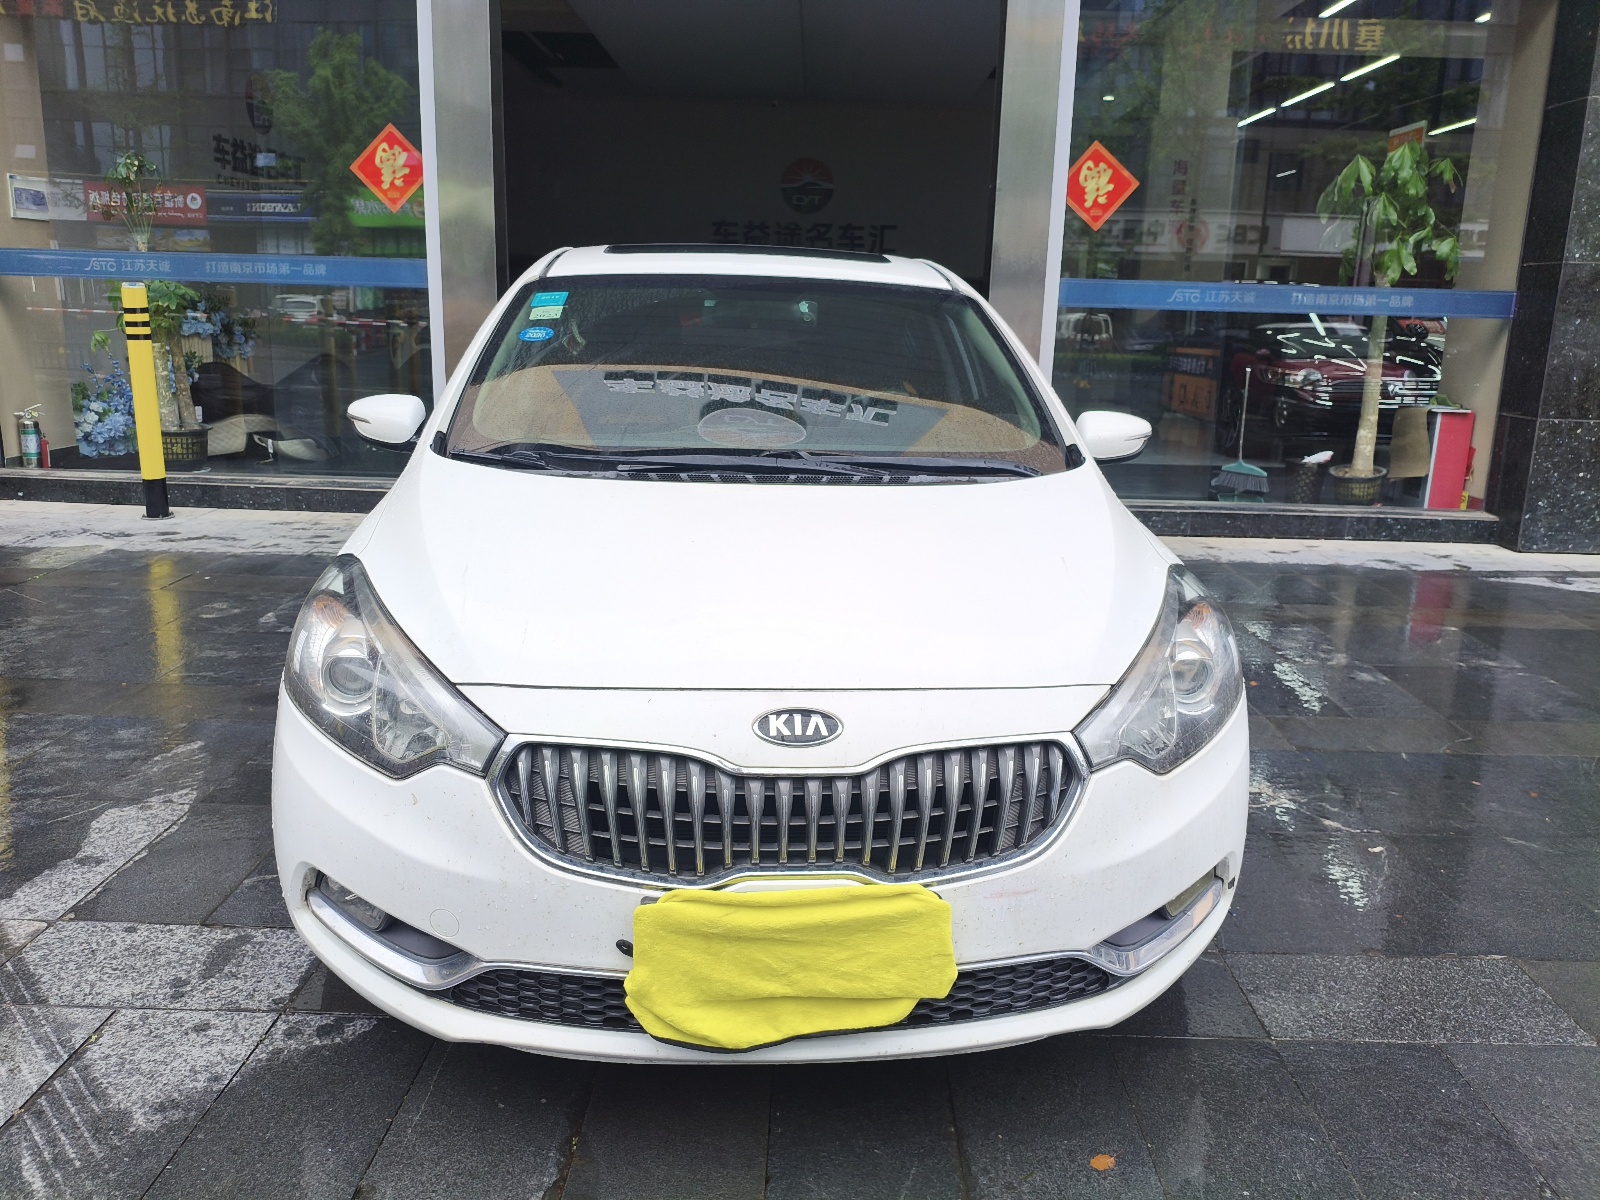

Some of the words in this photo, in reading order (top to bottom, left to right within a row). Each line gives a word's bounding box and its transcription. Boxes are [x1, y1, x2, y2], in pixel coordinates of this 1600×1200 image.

[121, 258, 172, 273] 江苏天诚
[204, 260, 327, 277] 打造南京市场第一品牌
[1205, 289, 1256, 305] 江苏天诚
[1290, 291, 1414, 308] 打造南京市场第一品牌
[767, 713, 829, 737] KIA
